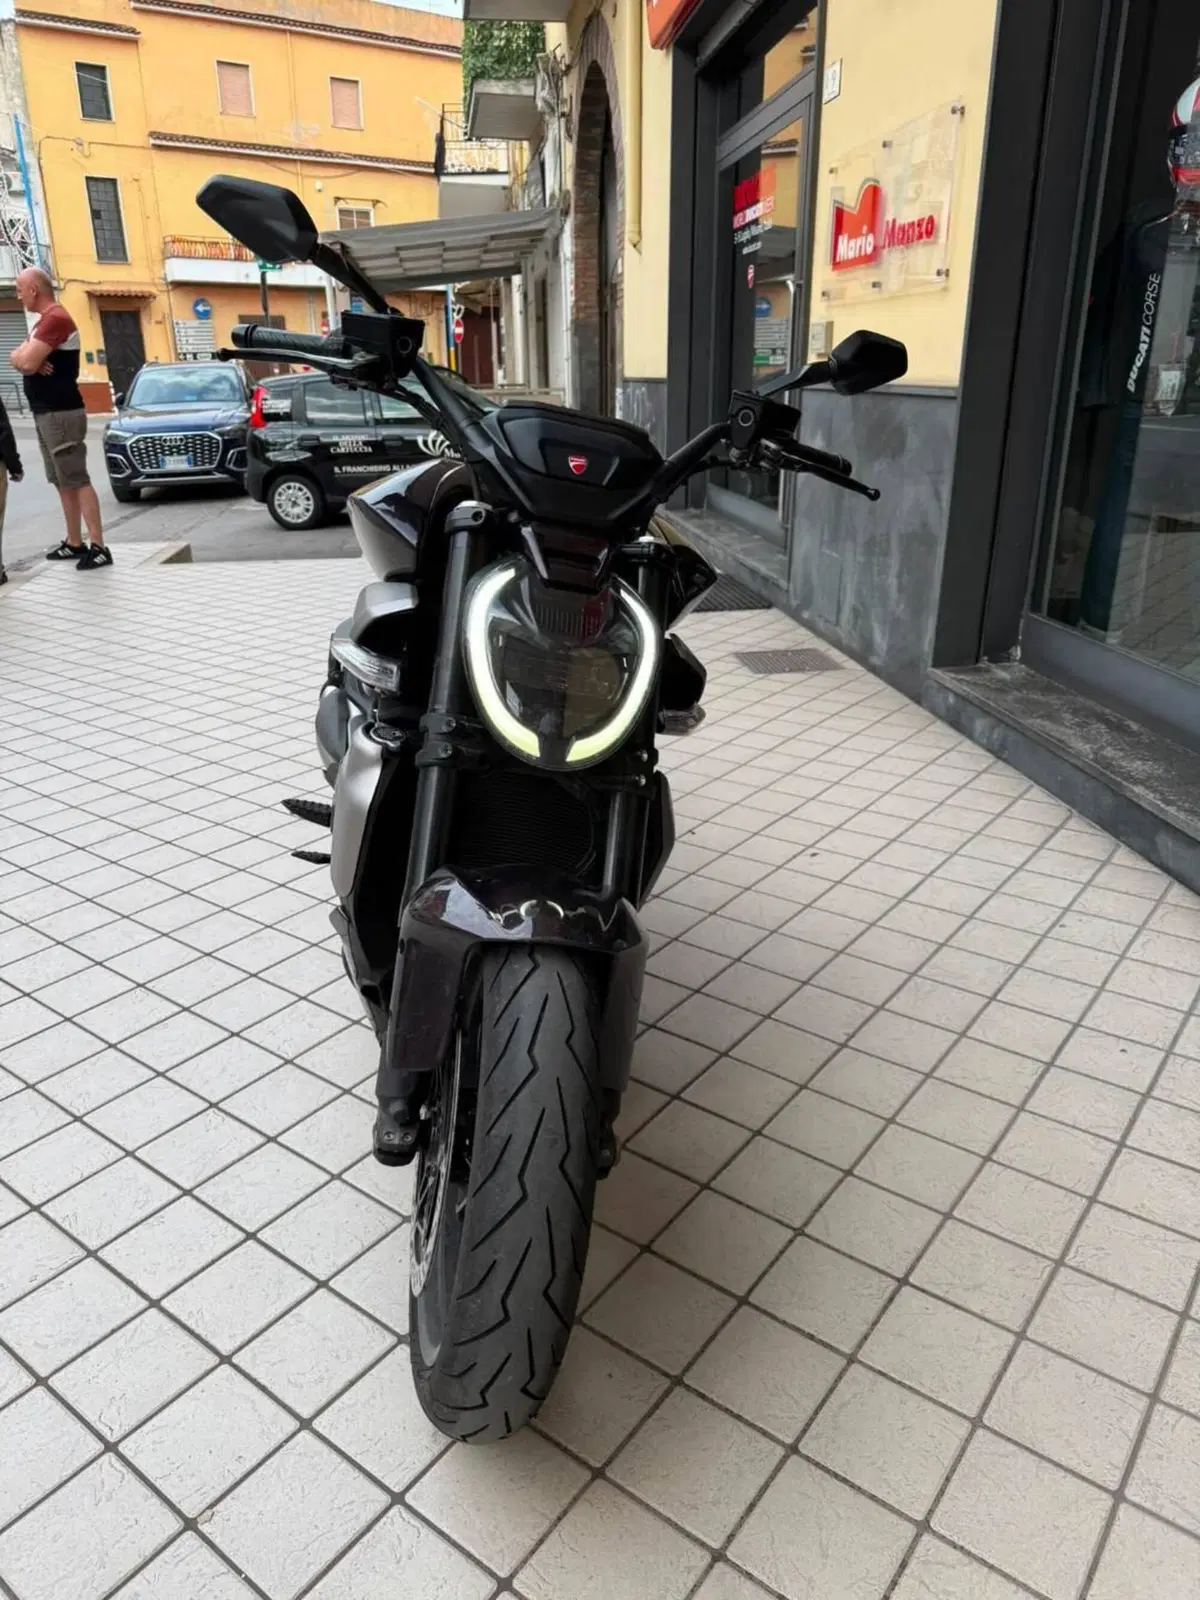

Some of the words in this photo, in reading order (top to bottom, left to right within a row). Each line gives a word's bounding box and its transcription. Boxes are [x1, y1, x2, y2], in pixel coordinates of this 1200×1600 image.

[835, 225, 875, 262] Mario
[882, 214, 936, 250] Manzo
[1126, 324, 1151, 393] DUCATI
[1142, 272, 1161, 326] CORSE
